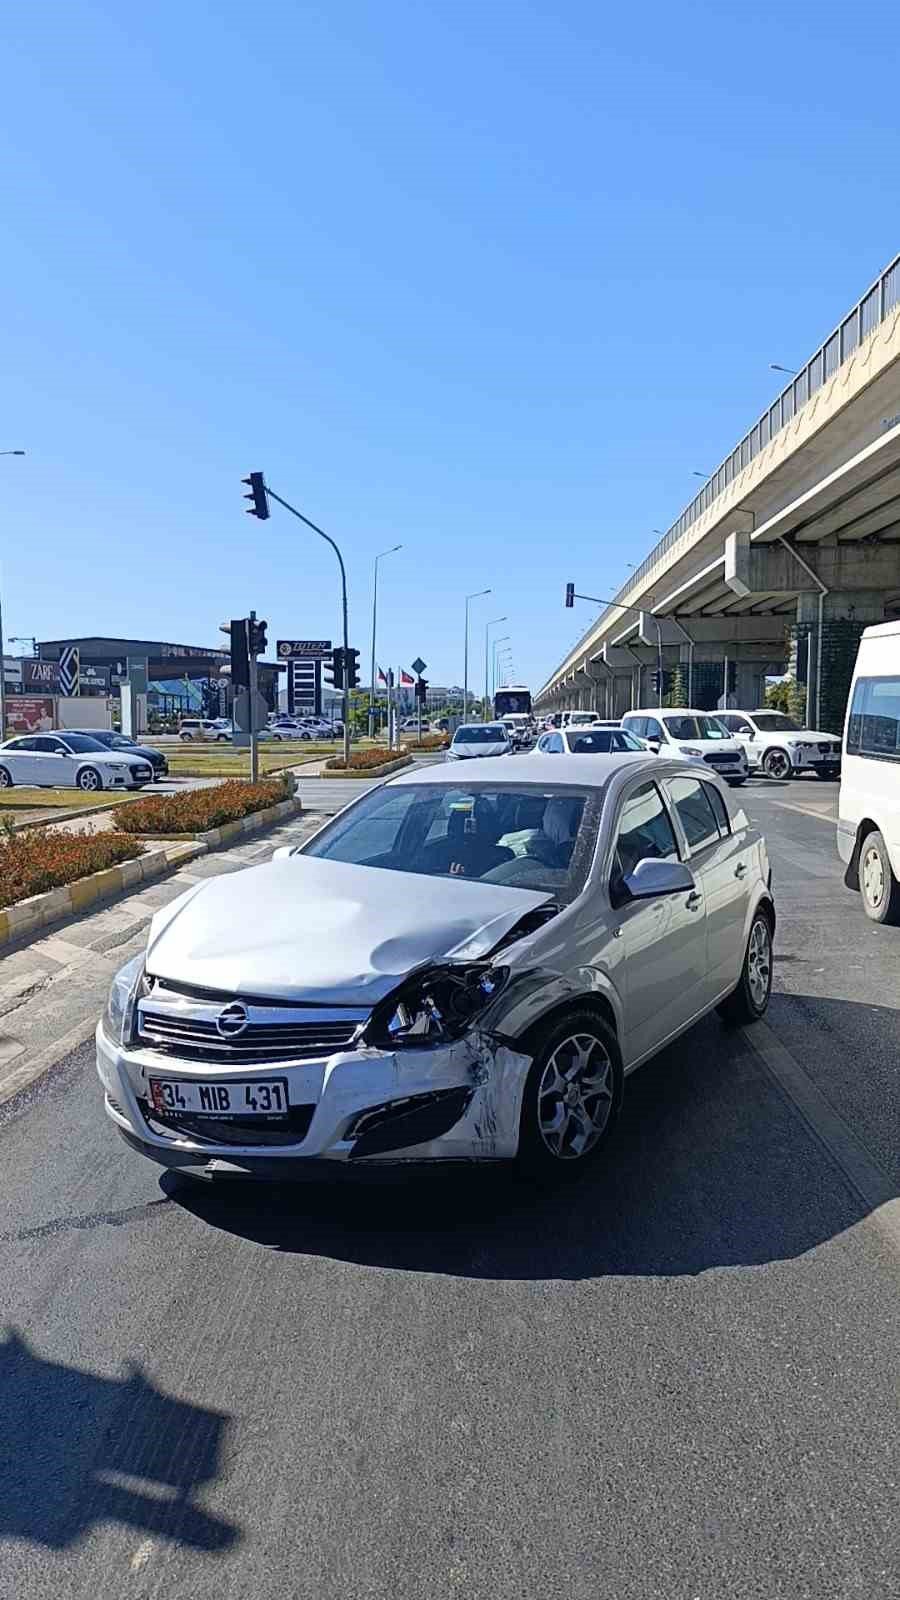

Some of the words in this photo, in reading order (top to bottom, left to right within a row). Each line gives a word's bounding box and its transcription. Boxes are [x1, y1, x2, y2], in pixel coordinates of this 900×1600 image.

[163, 1084, 186, 1109] 34
[199, 1086, 231, 1111] MIB
[245, 1085, 282, 1111] 431
